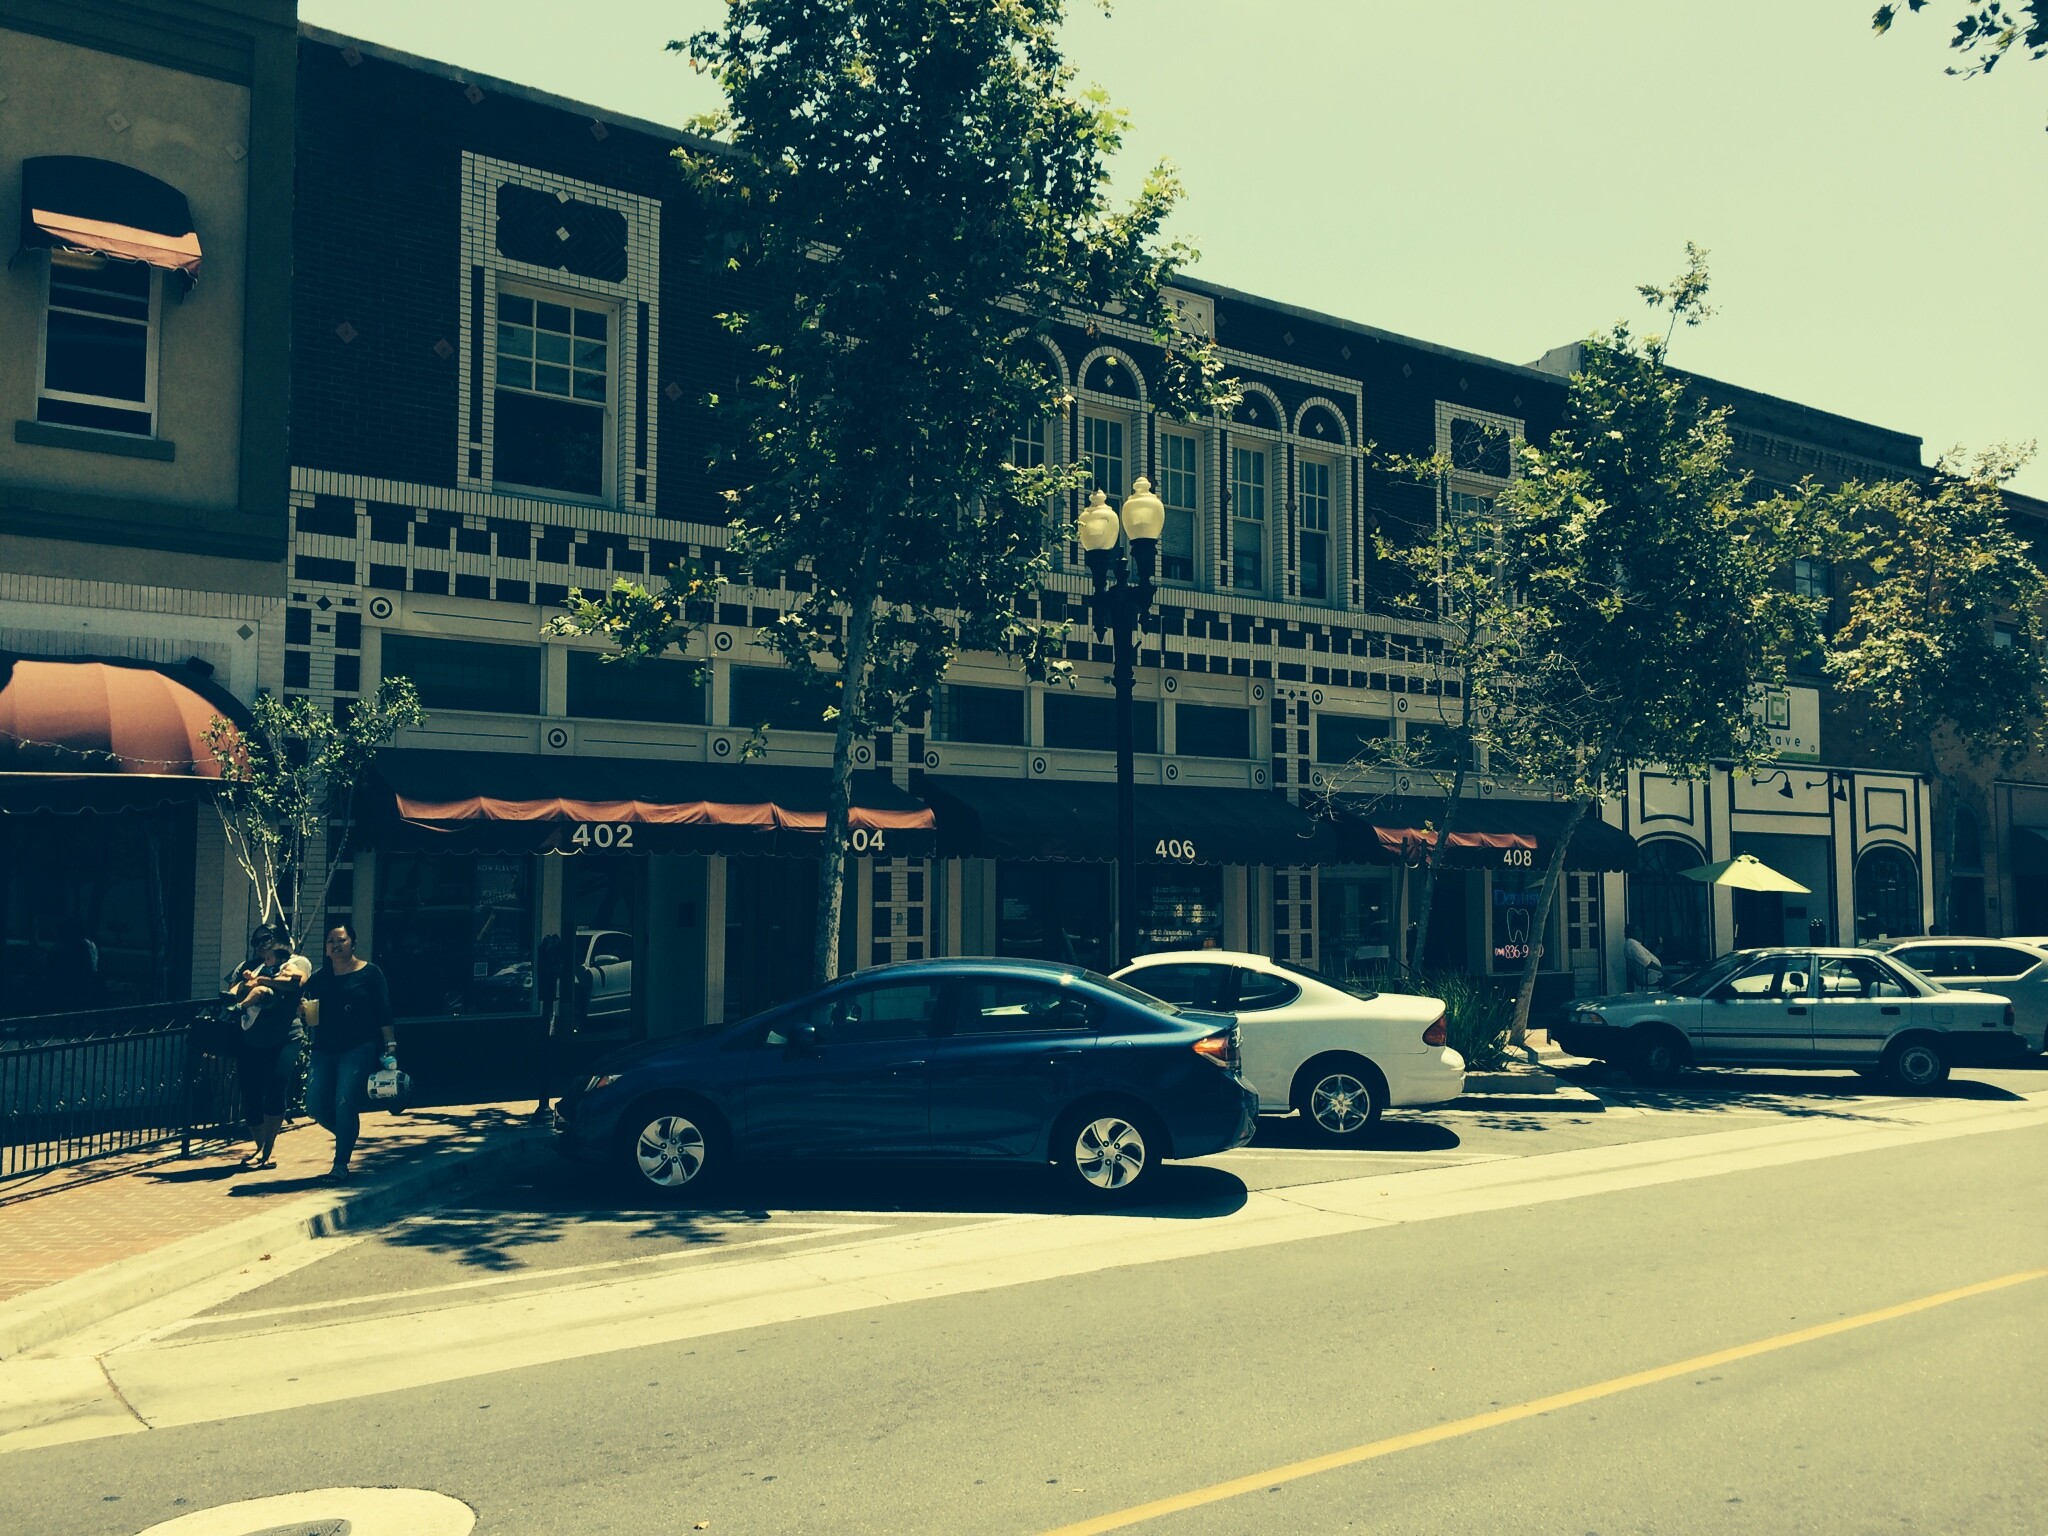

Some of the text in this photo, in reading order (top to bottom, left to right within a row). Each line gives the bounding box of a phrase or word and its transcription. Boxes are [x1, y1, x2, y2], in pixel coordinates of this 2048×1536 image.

[1766, 734, 1801, 747] ave
[571, 823, 634, 848] 402
[1155, 839, 1196, 859] 406
[1503, 849, 1532, 867] 408
[1505, 944, 1545, 959] 836-90
